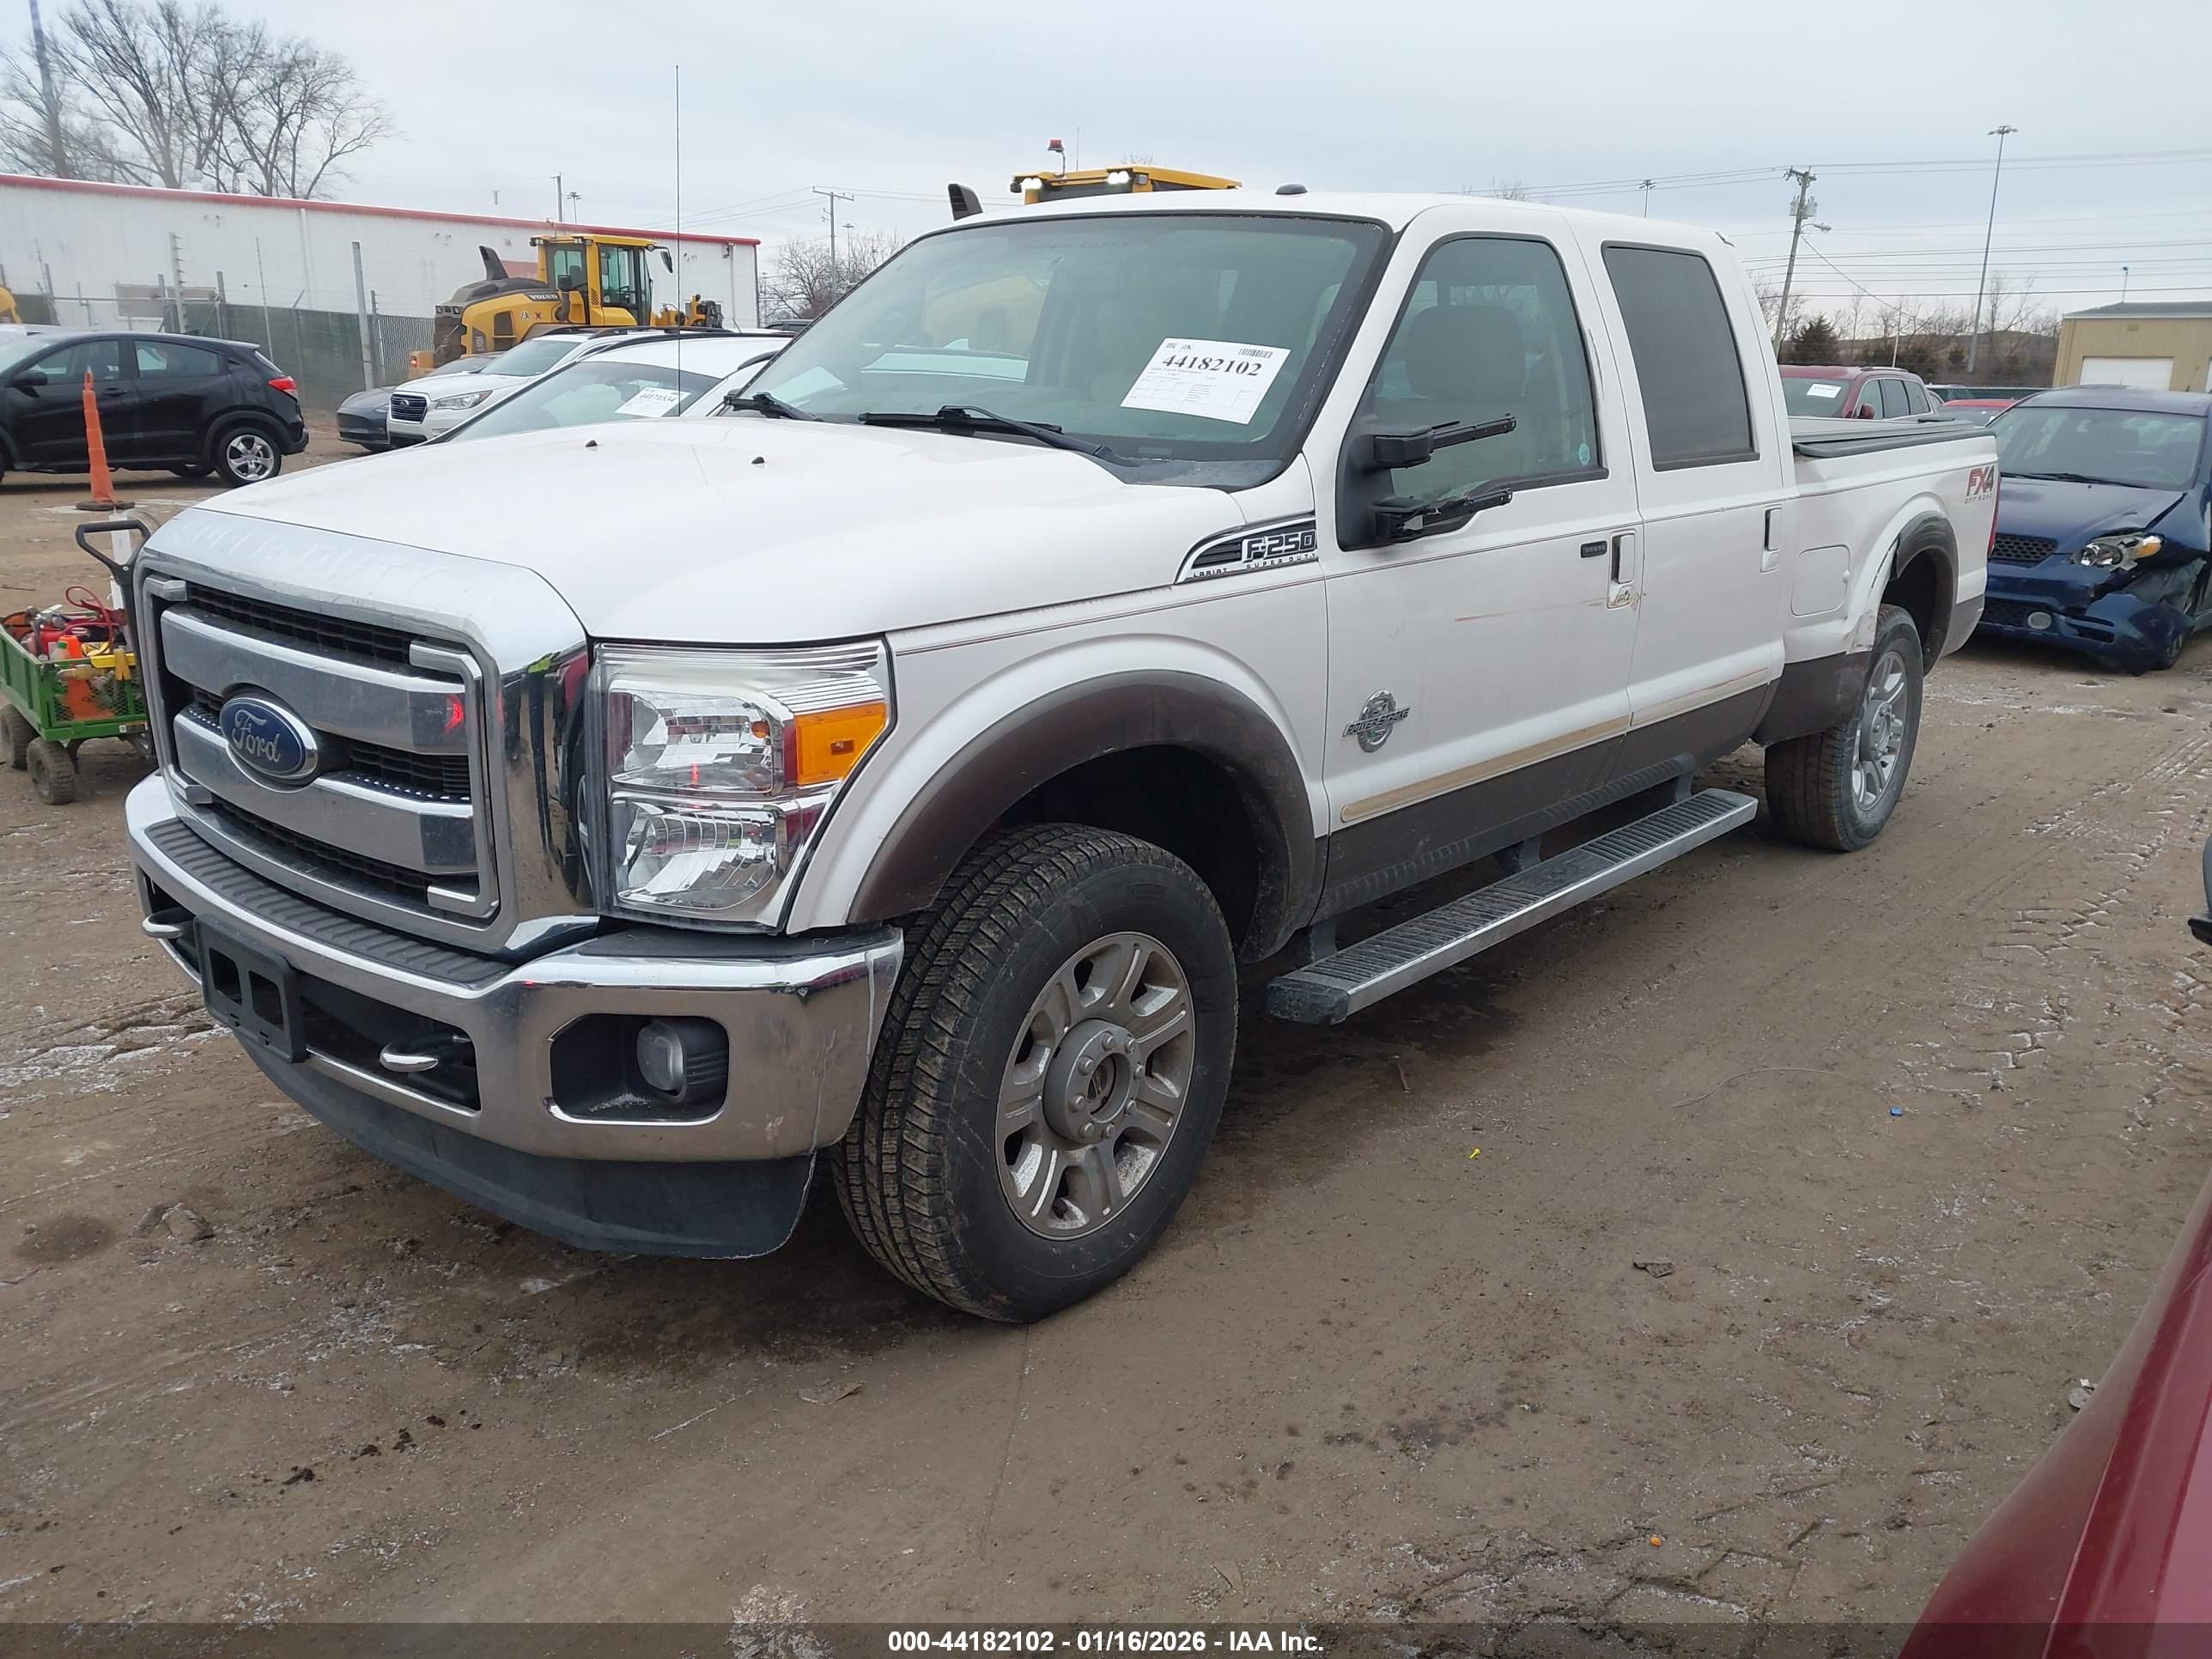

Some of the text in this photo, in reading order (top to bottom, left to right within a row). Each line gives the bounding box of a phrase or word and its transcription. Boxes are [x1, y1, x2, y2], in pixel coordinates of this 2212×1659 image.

[1162, 354, 1262, 376] 44182102
[1966, 465, 1995, 496] FX4
[1241, 529, 1317, 562] F-250
[1193, 568, 1228, 578] LARIAT
[1246, 552, 1317, 570] SUPER DUTY
[232, 709, 281, 763] Ford
